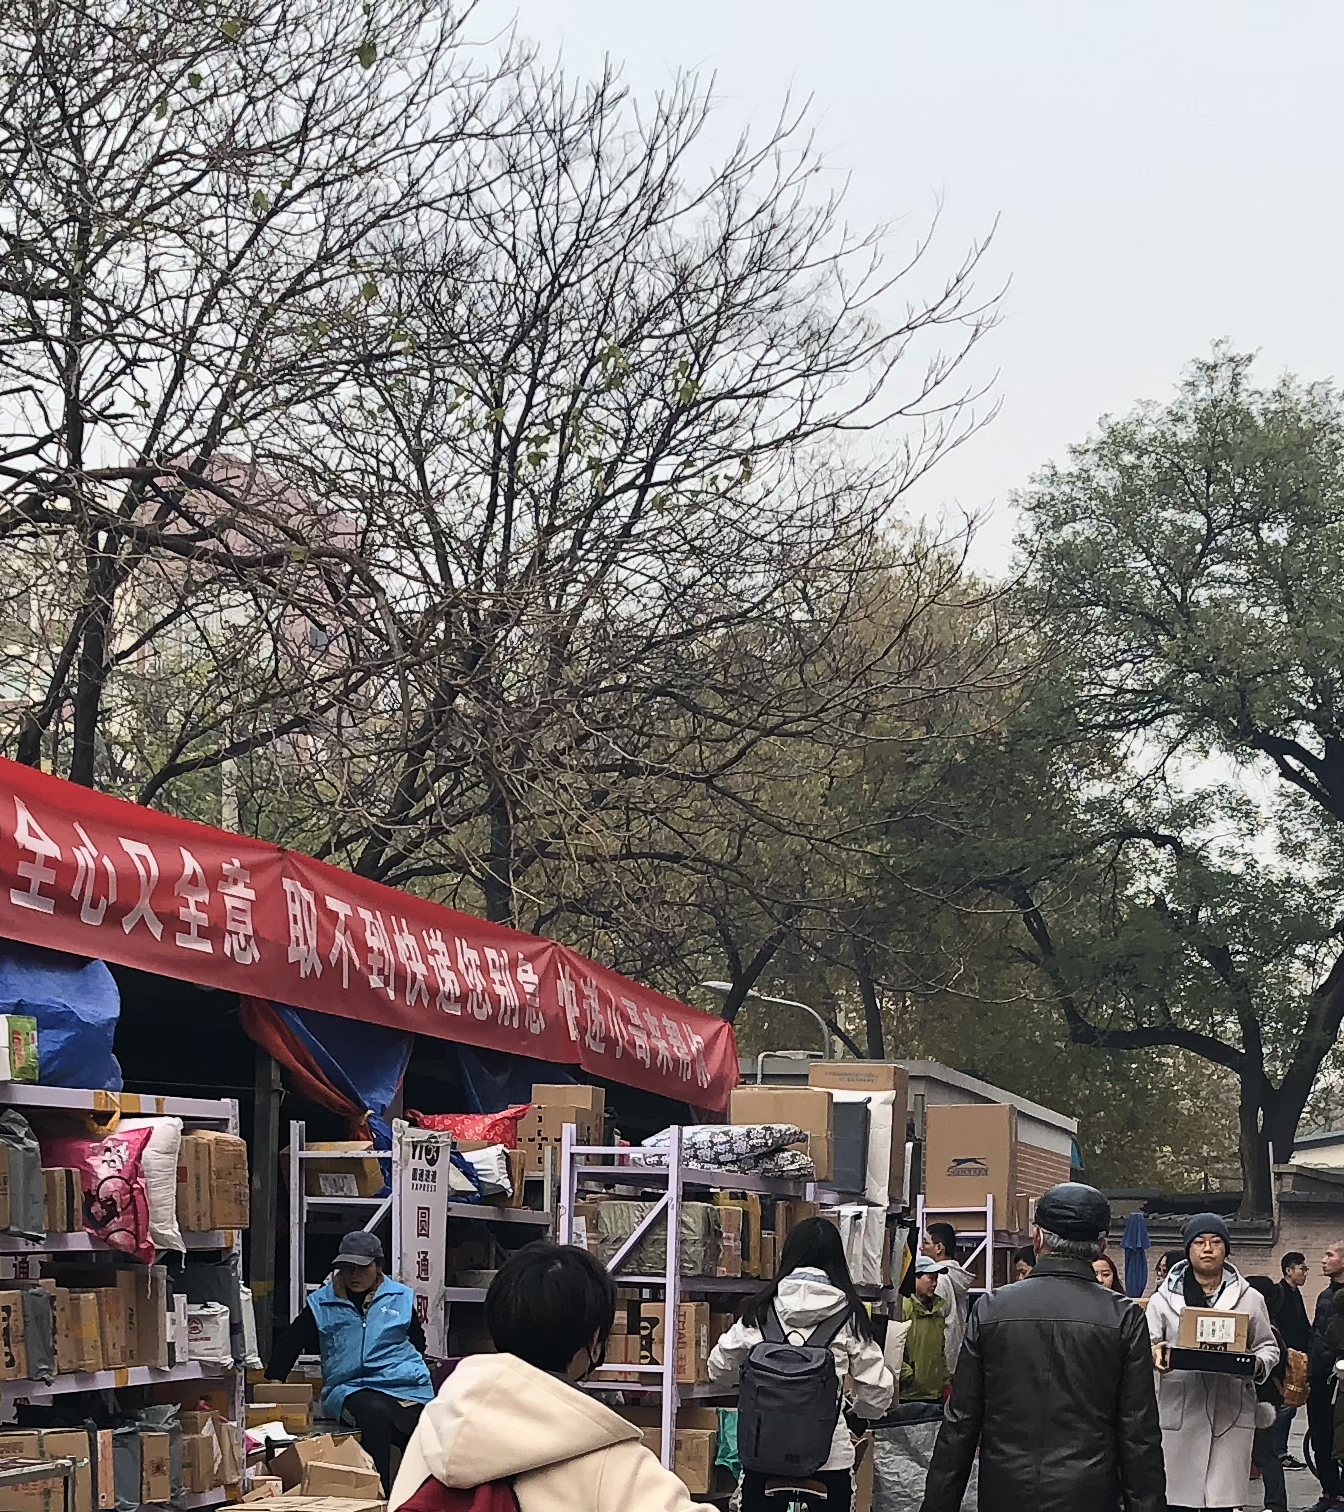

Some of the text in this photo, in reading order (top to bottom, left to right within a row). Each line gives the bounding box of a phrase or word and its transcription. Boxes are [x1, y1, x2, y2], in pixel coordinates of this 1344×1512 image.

[282, 876, 546, 1035] 取不到快递您别急
[411, 1183, 437, 1193] EXPRESS
